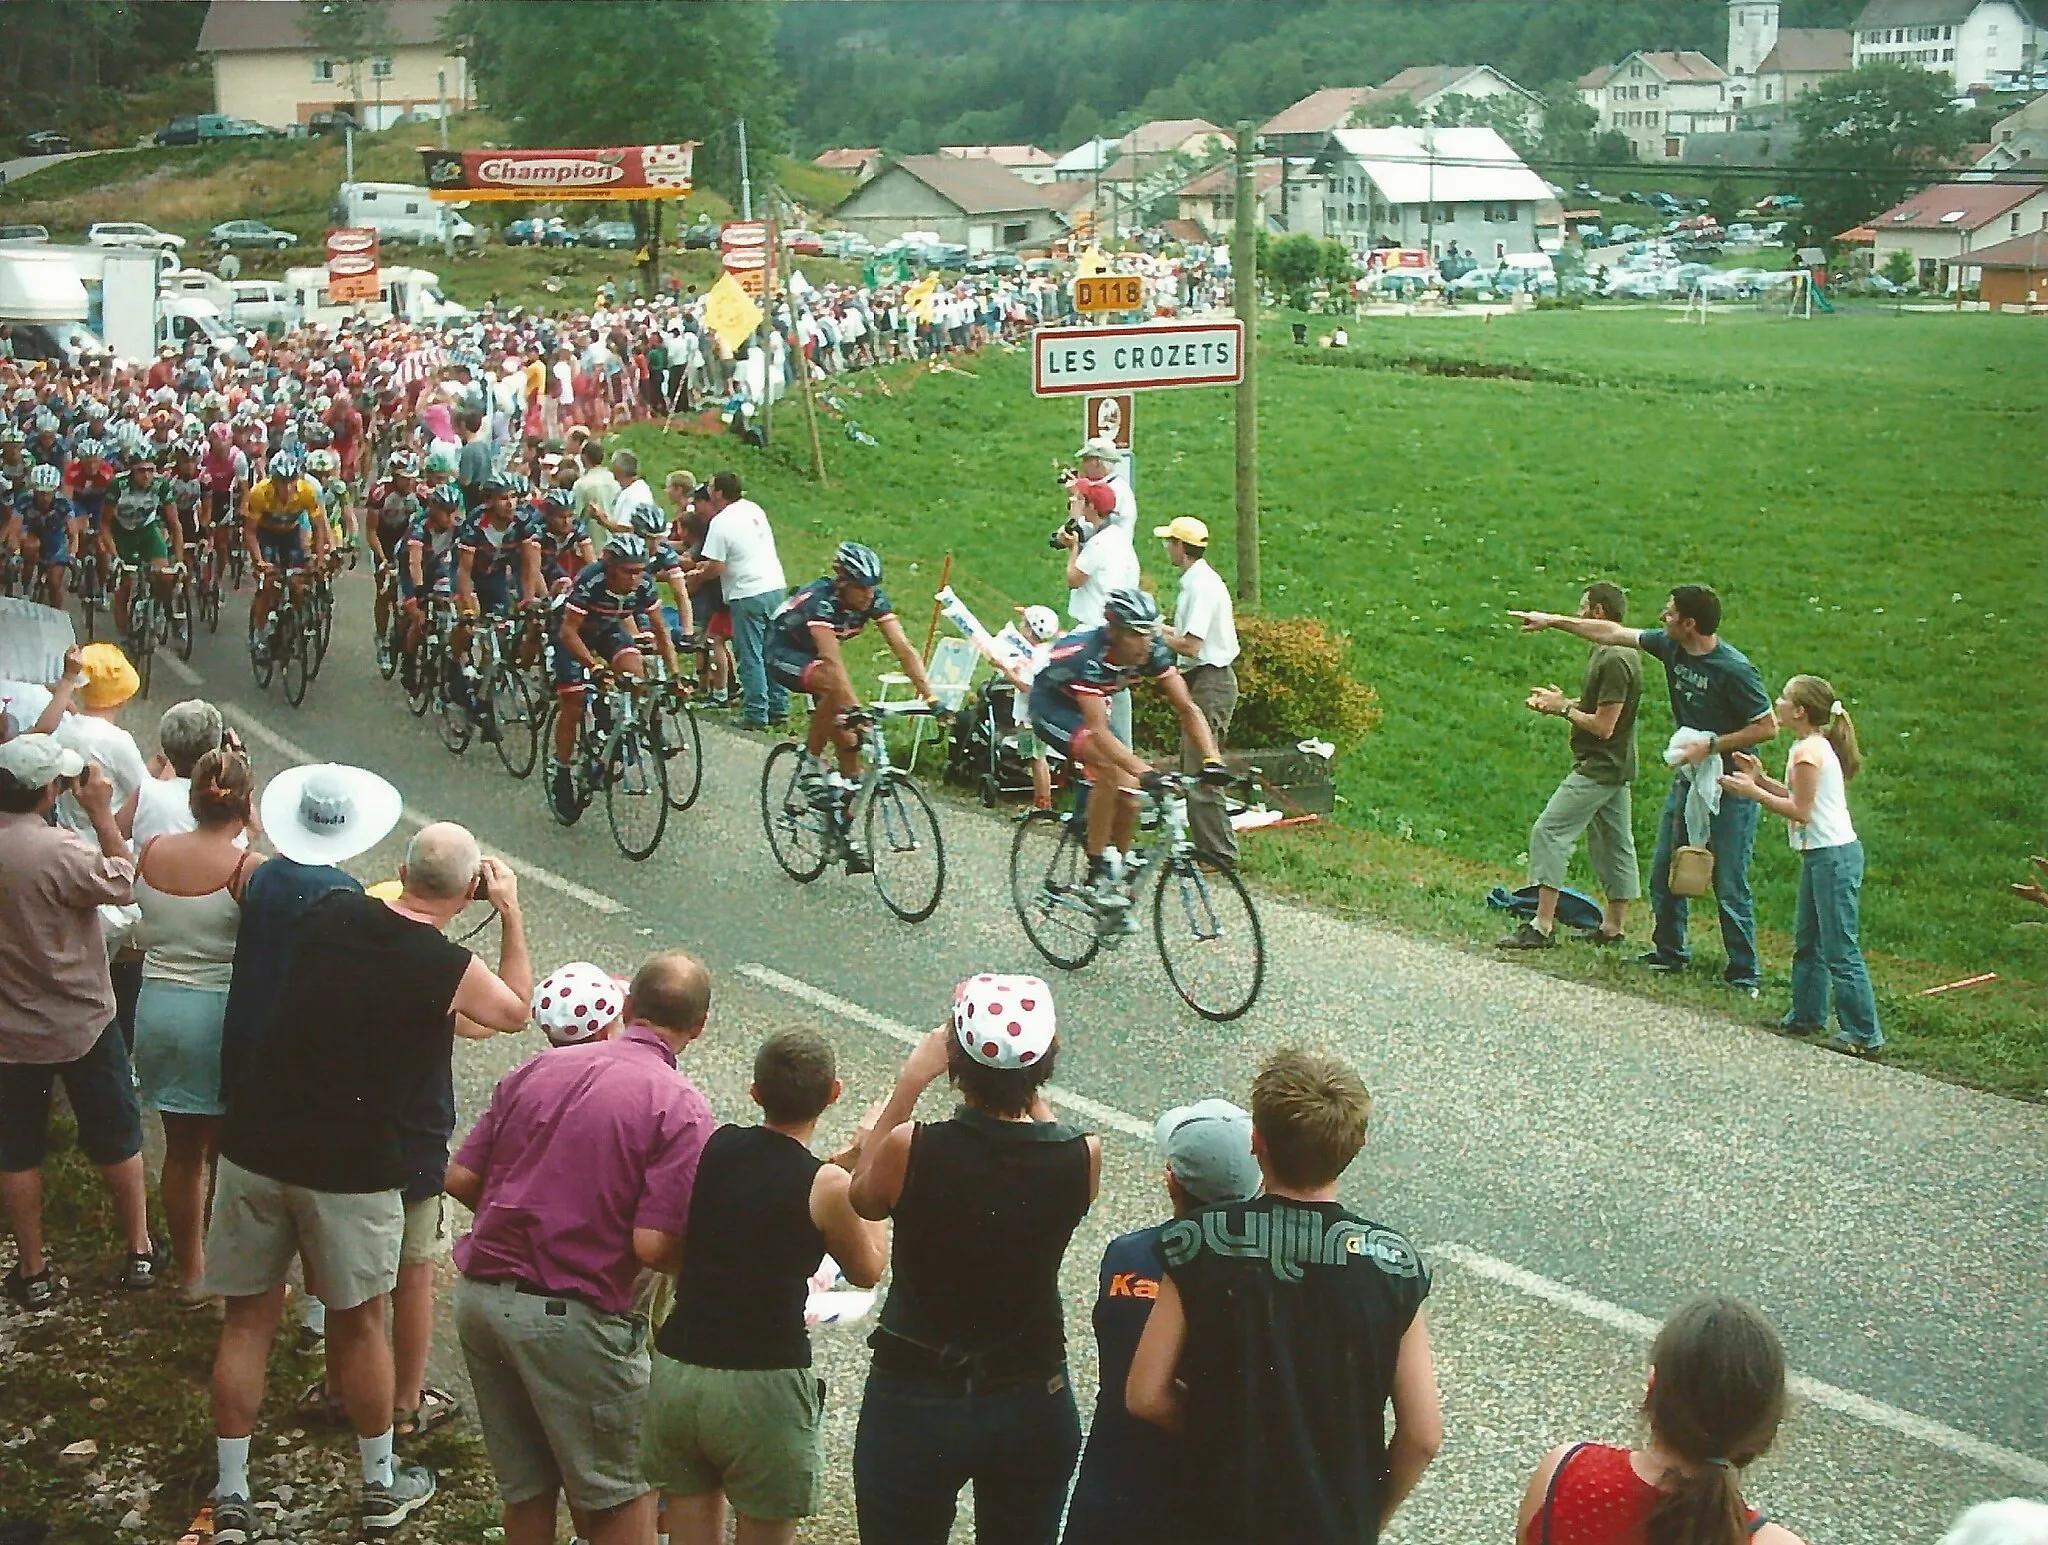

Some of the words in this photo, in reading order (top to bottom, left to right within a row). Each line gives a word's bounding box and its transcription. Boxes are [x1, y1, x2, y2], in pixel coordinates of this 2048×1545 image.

[483, 162, 612, 183] Champion
[1079, 283, 1092, 305] D
[1099, 281, 1140, 304] 118
[1050, 349, 1096, 374] LES
[1114, 342, 1229, 370] CROZETS
